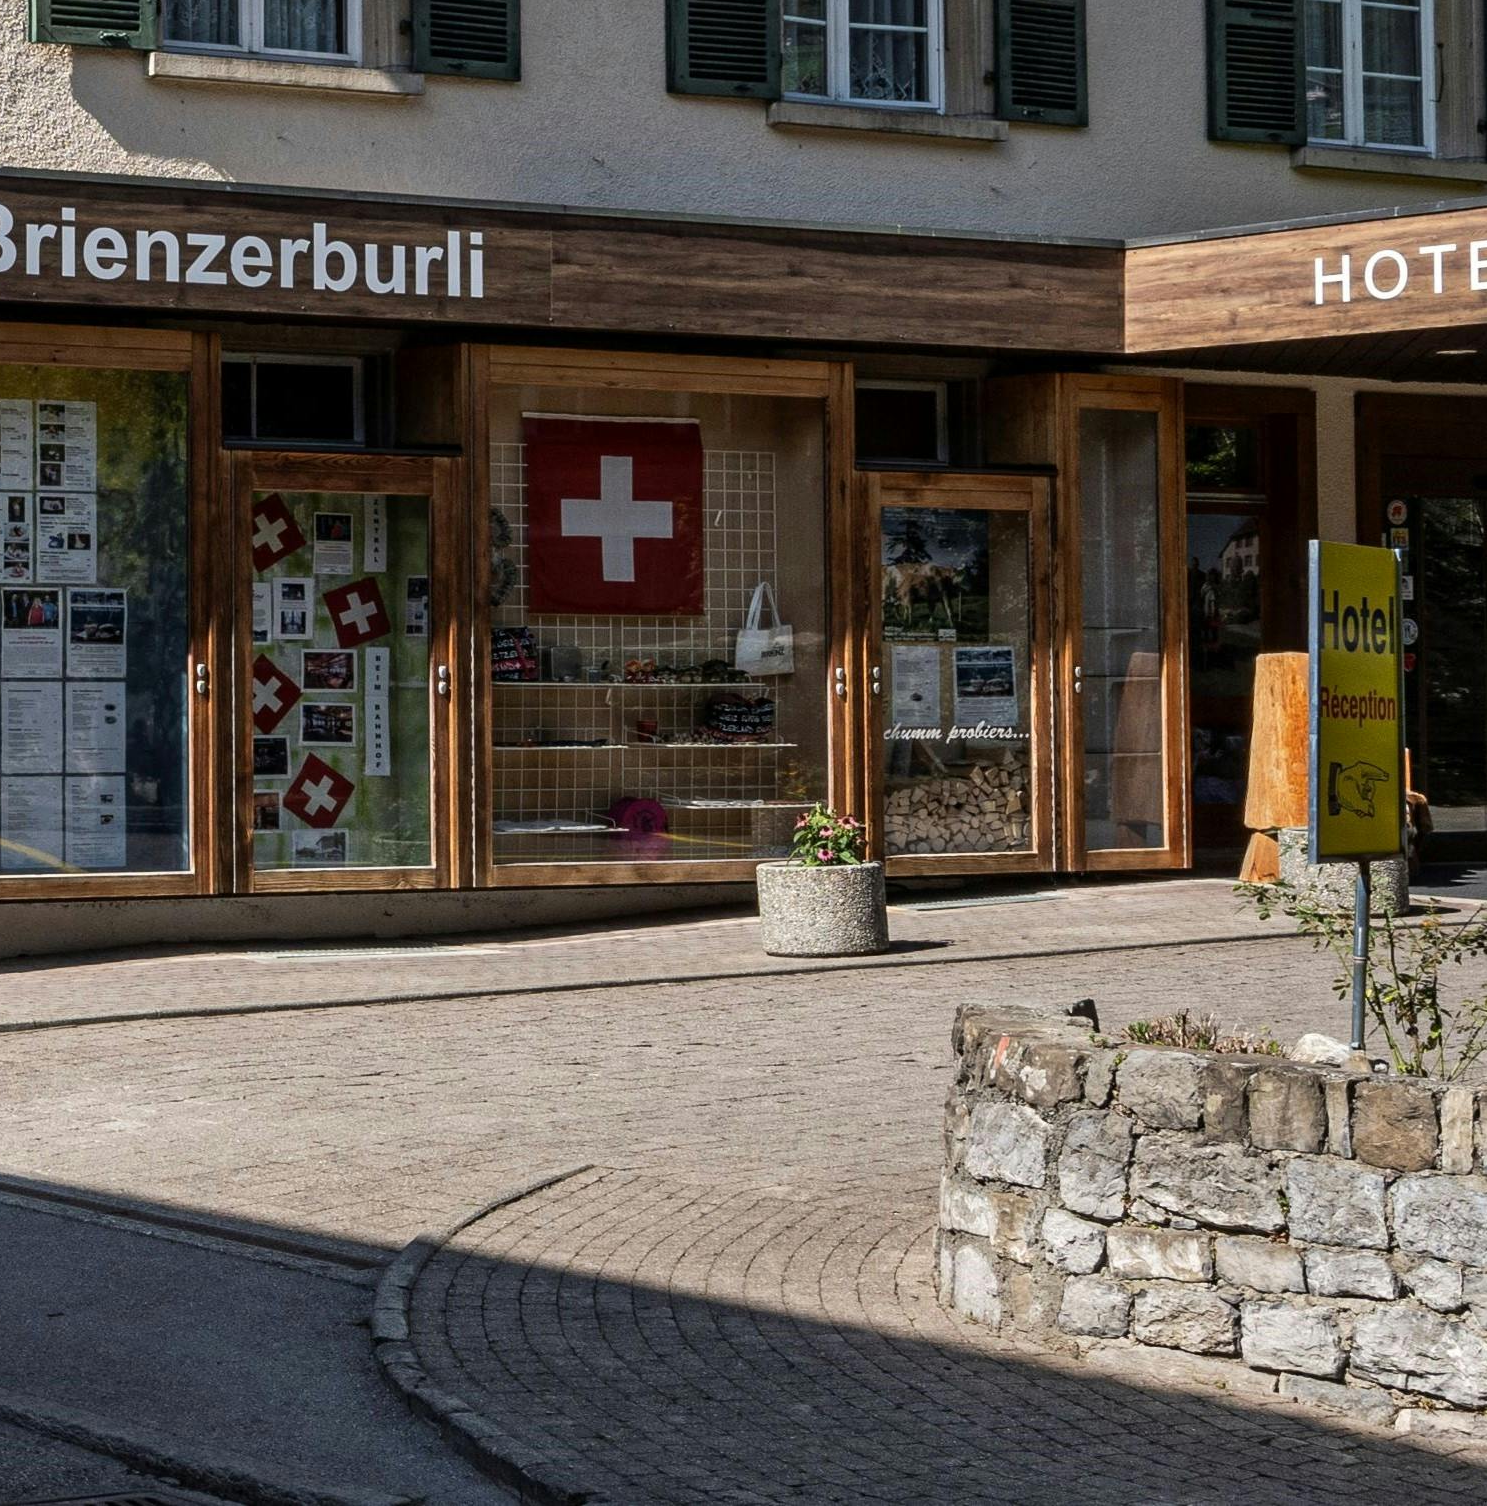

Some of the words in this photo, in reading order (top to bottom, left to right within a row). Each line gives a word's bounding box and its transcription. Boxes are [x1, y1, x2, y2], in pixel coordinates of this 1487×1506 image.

[1319, 588, 1395, 654] Hotel
[373, 655, 382, 691] BEIM
[1319, 684, 1396, 728] Réception
[374, 704, 383, 769] BAHNHOF
